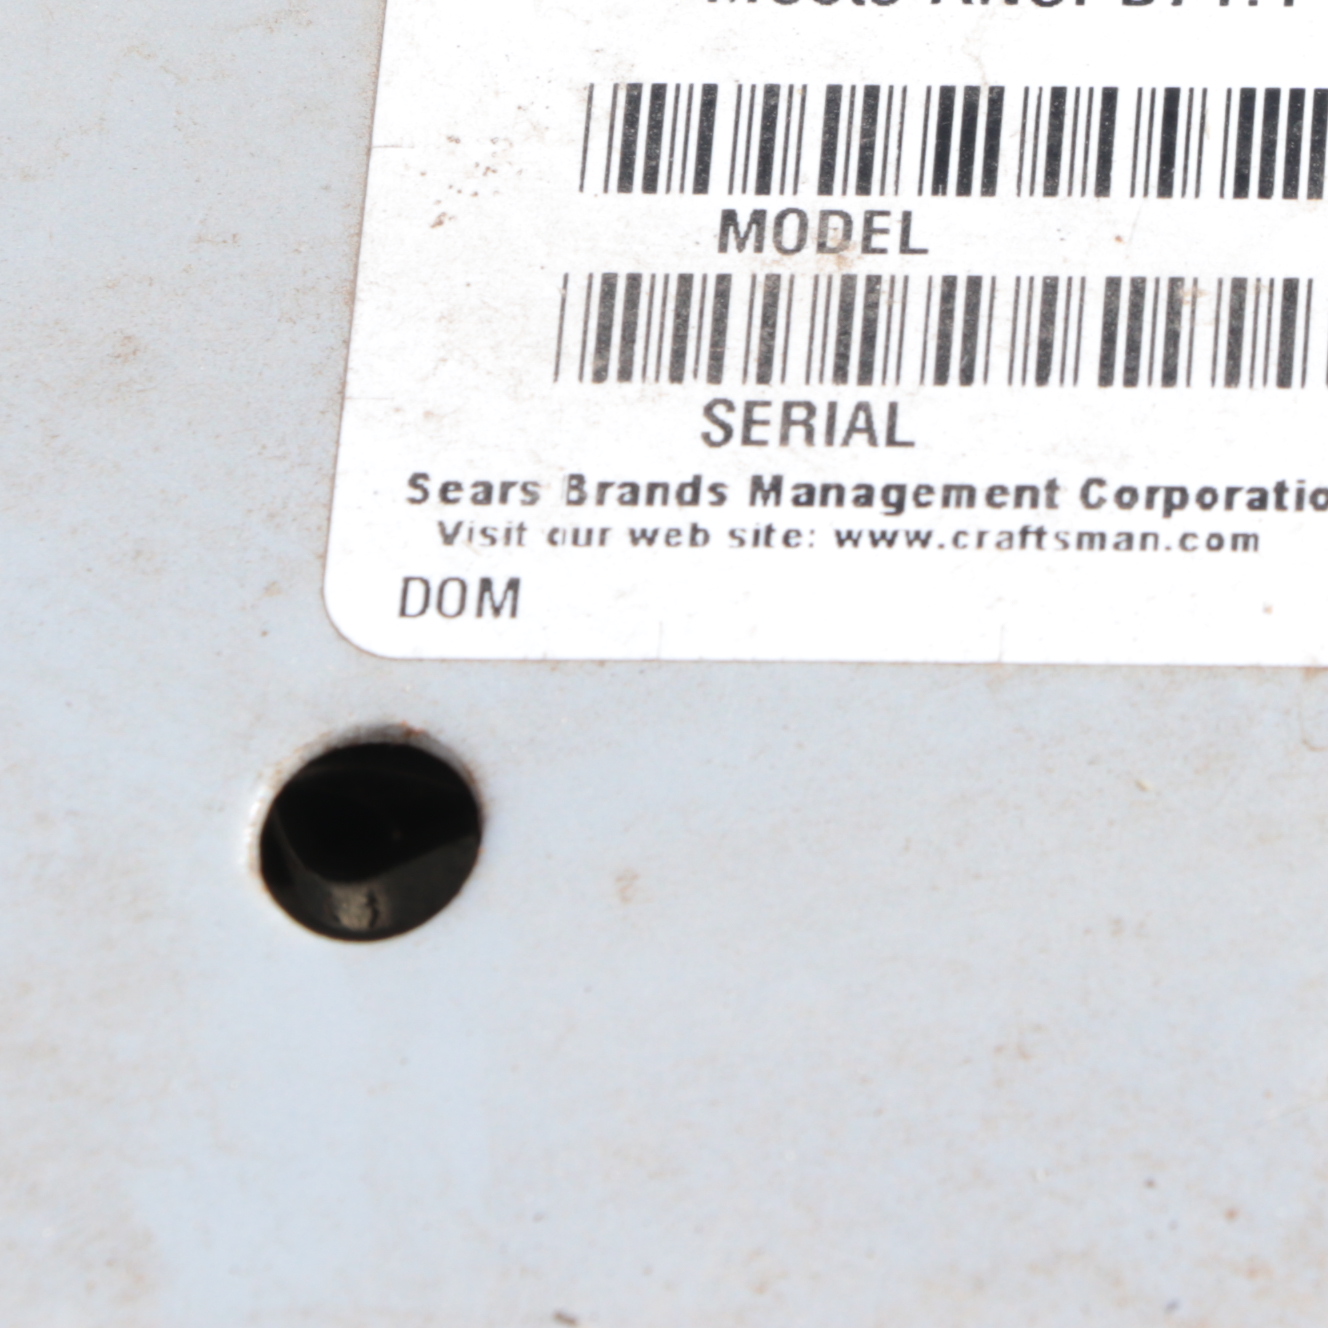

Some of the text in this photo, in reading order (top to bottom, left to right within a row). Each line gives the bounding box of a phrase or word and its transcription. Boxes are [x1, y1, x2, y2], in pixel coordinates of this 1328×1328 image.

[717, 207, 929, 257] MODEL
[700, 397, 916, 449] SERIAL
[406, 472, 541, 507] Sears
[565, 473, 728, 507] Brands
[748, 473, 1061, 517] Management
[437, 520, 527, 547] Visit
[628, 522, 711, 548] web
[728, 523, 815, 549] site:
[834, 524, 1260, 552] www.craftsman.com
[398, 576, 521, 619] DOM
